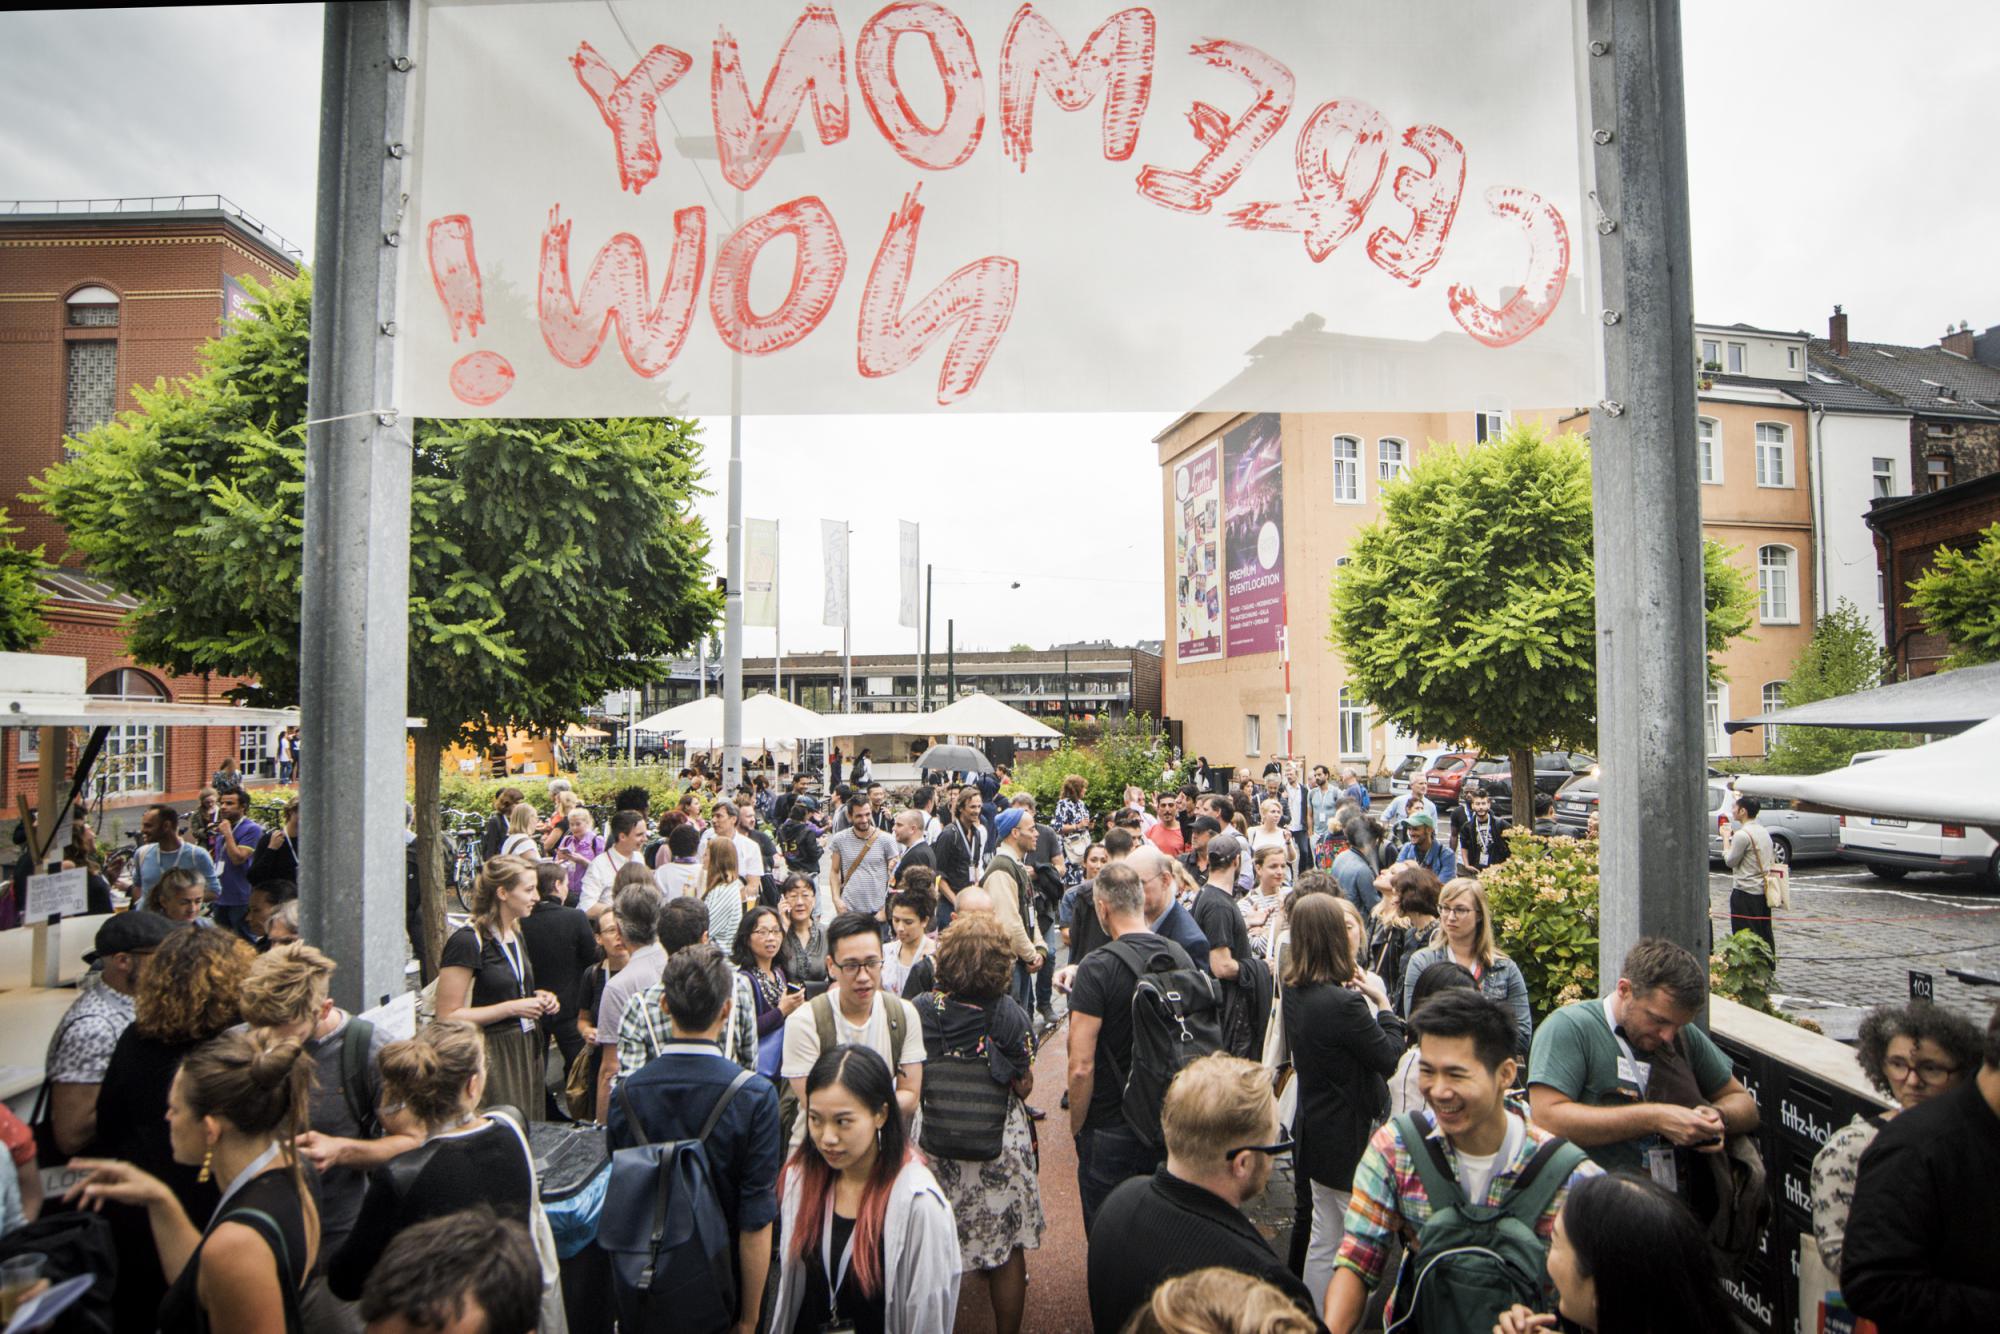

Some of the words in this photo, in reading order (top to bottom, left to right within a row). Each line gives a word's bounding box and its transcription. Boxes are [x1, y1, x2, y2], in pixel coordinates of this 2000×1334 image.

[1229, 564, 1257, 582] PREMIUM
[1229, 573, 1280, 596] EVENTLOCATION
[1913, 979, 1930, 997] 102
[1781, 1099, 1831, 1146] fritz-kol
[1785, 1173, 1813, 1213] fritz-
